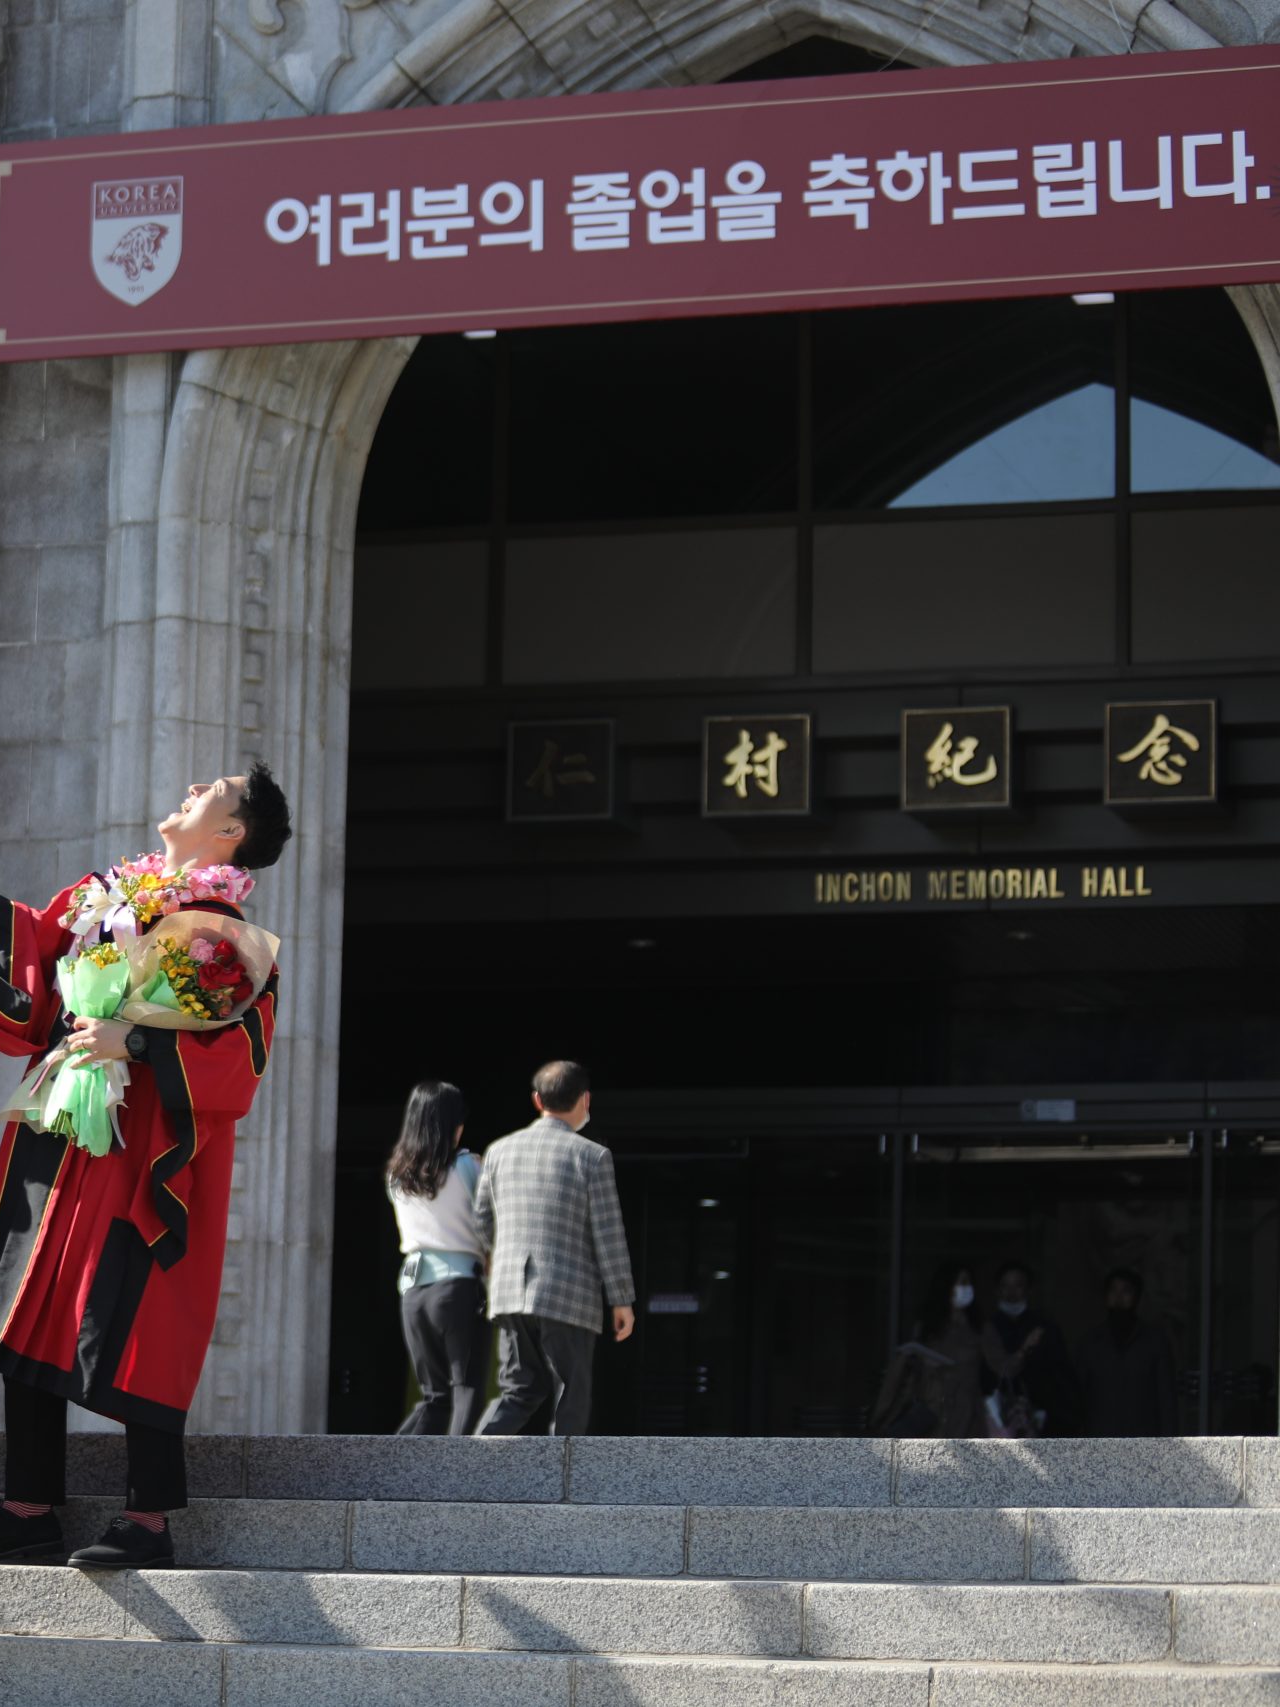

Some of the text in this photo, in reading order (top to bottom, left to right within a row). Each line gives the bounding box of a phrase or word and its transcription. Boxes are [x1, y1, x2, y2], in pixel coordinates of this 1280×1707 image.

[101, 184, 176, 203] KOREA
[265, 130, 1271, 266] 여러분의 졸업을 축하드립니다.
[101, 202, 177, 216] UNIVERSITY
[816, 866, 1152, 903] INCHON MEMORIAL HALL
